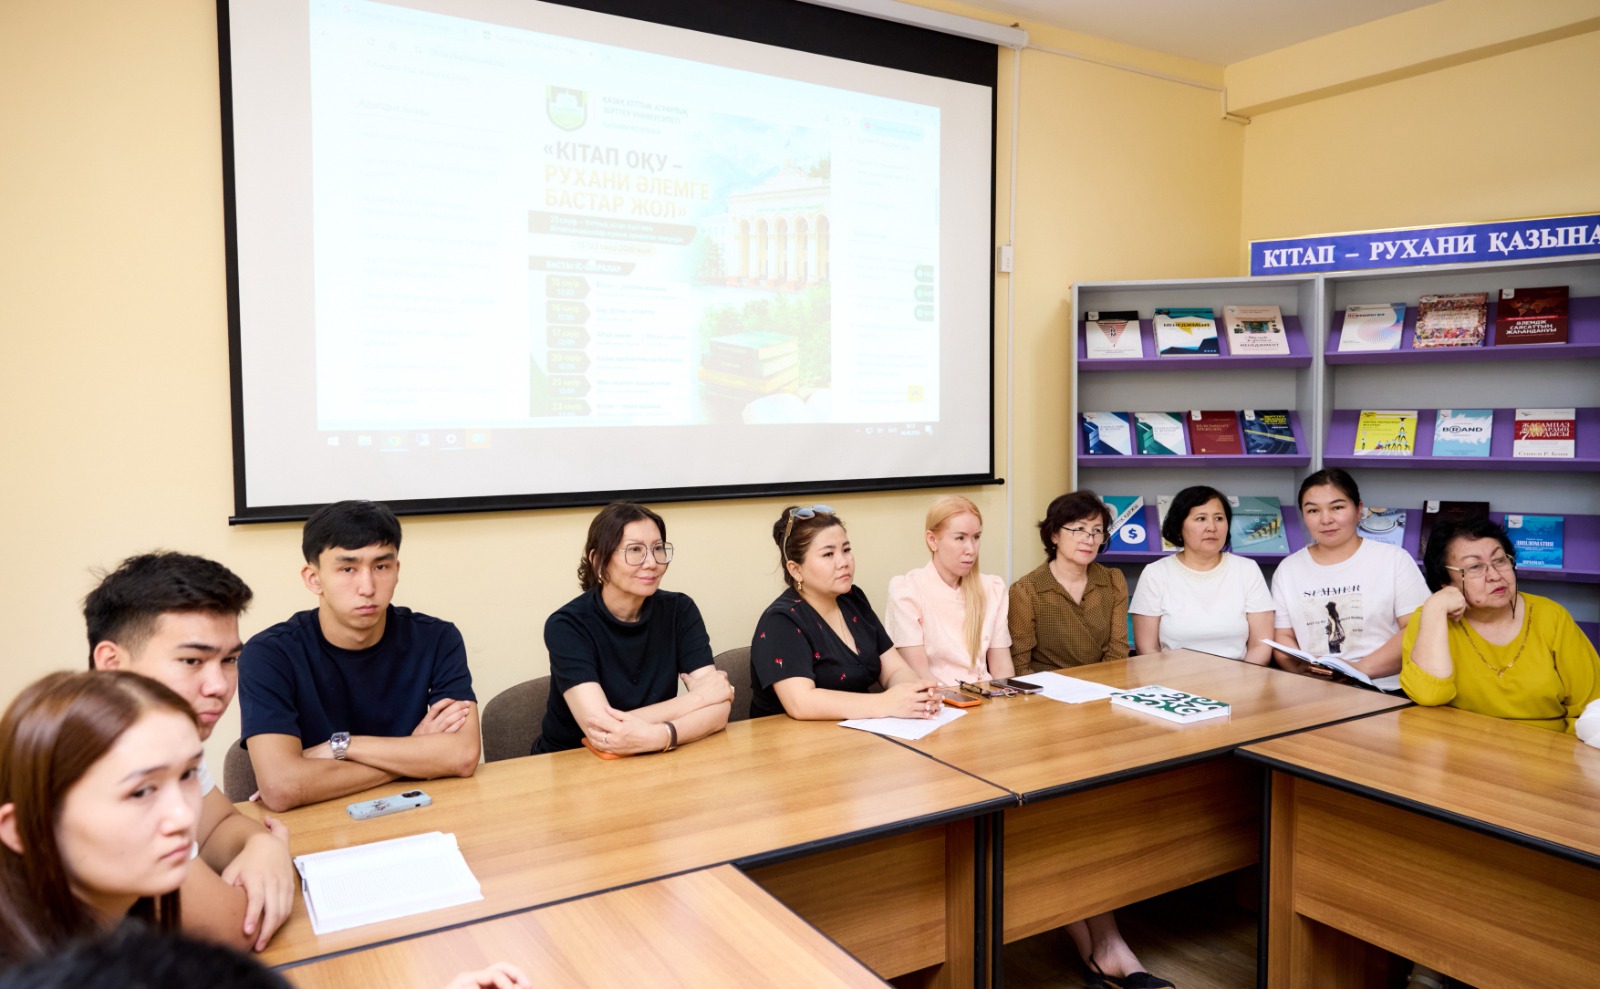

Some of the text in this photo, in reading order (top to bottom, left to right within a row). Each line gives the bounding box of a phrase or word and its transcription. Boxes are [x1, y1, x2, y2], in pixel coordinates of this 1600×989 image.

[543, 140, 619, 167] «КІТАП
[625, 149, 669, 175] ОҚУ
[544, 164, 711, 202] РУХАНИ ӘЛЕМГЕ
[544, 187, 687, 220] БАСТАР ЖОЛ»
[1263, 245, 1334, 268] КІТАП
[1369, 234, 1476, 261] РУХАНИ
[1488, 224, 1600, 255] ҚАЗЫНА
[1519, 431, 1529, 441] 7
[1302, 584, 1361, 597] SUMMER
